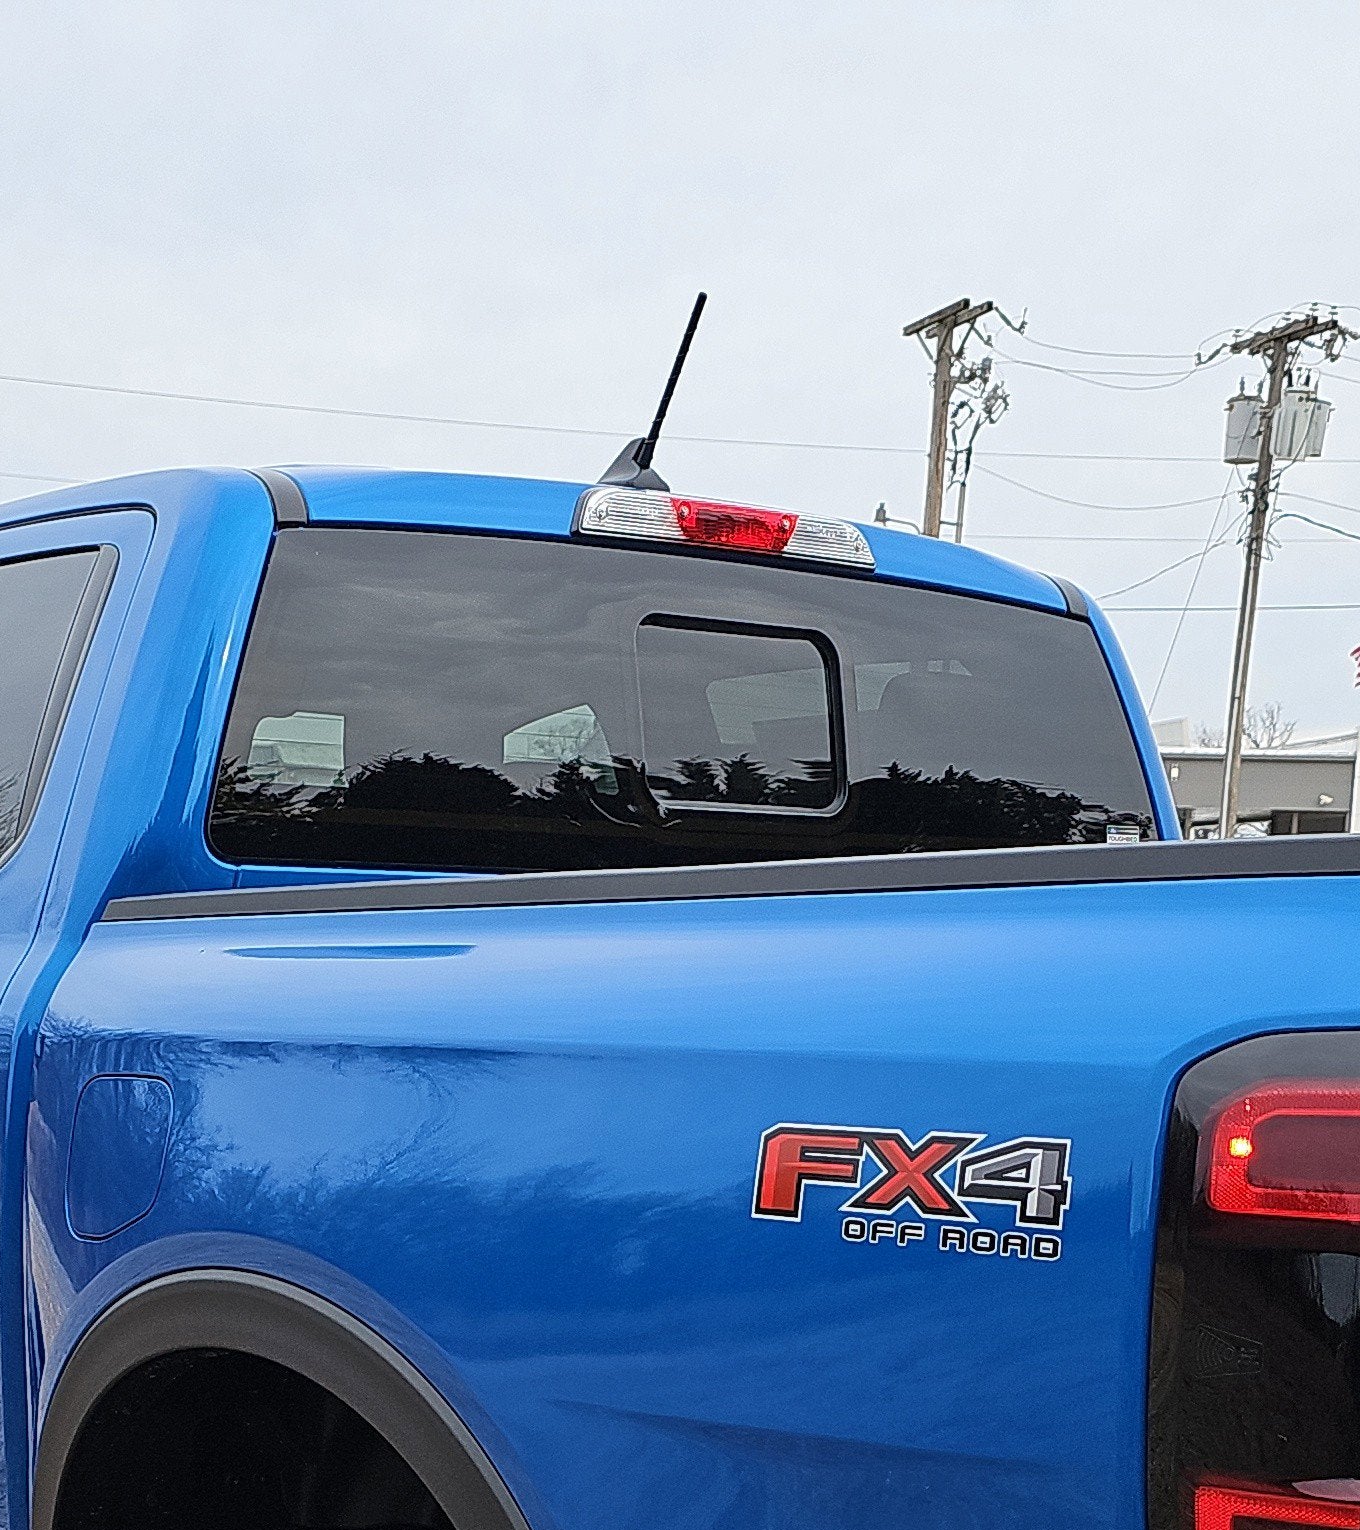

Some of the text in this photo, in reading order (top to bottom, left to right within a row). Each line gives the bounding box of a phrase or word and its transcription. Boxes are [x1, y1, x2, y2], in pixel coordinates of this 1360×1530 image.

[751, 1122, 1072, 1231] FX4
[841, 1217, 1062, 1262] OFF ROAD
